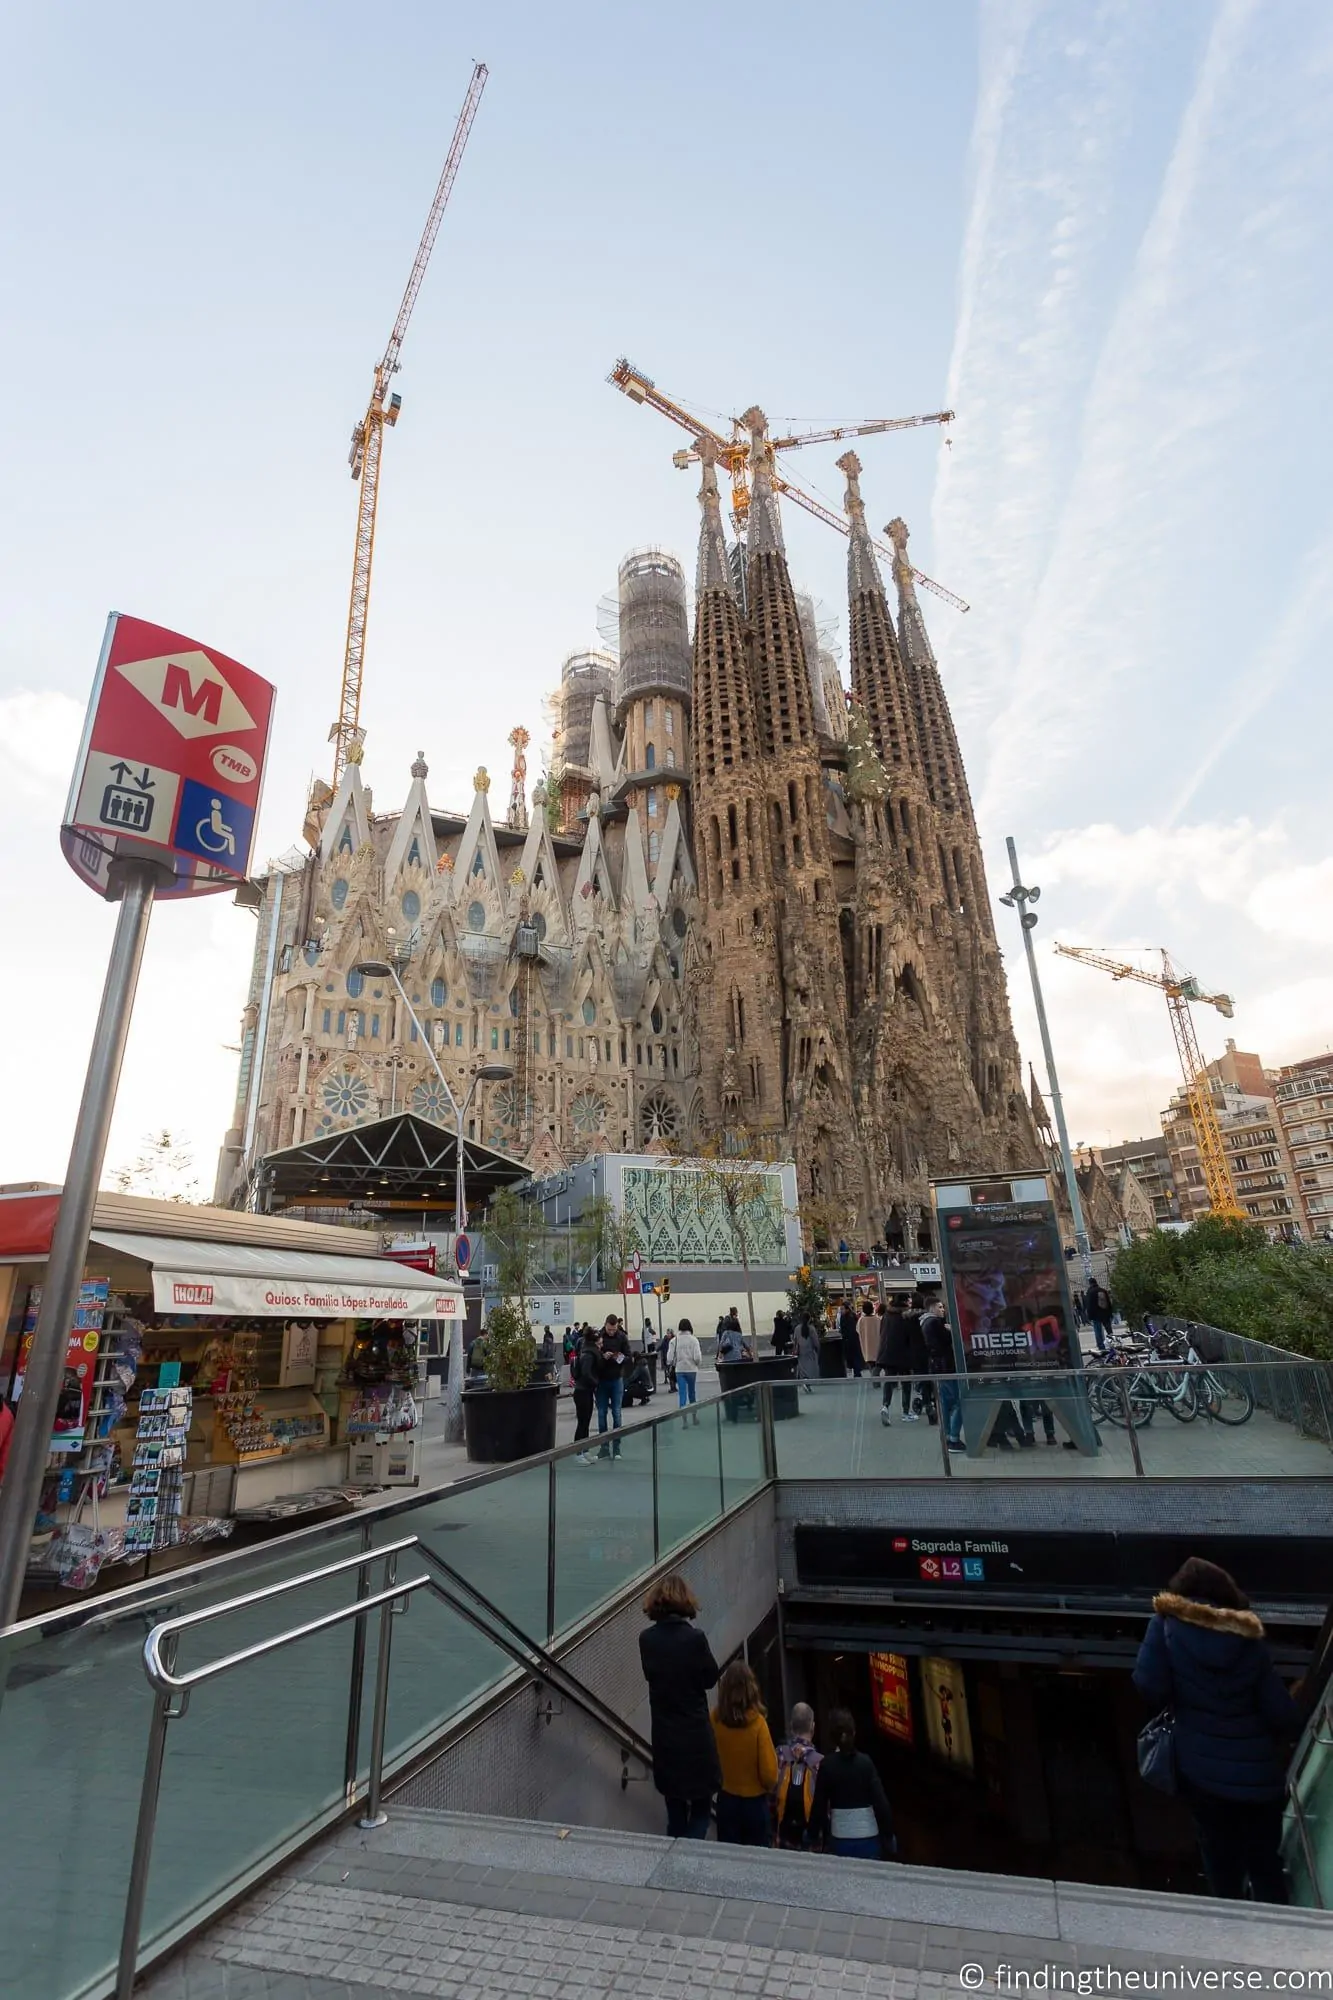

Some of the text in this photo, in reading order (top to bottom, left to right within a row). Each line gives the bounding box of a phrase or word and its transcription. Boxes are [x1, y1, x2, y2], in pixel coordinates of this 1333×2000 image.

[160, 663, 223, 726] M
[220, 754, 251, 777] TMB
[175, 1286, 212, 1304] ¡HOLA!
[342, 1295, 367, 1311] López
[970, 1330, 1032, 1349] MESSI
[911, 1539, 961, 1554] Sagrada
[942, 1561, 960, 1576] L2
[964, 1562, 982, 1576] L5
